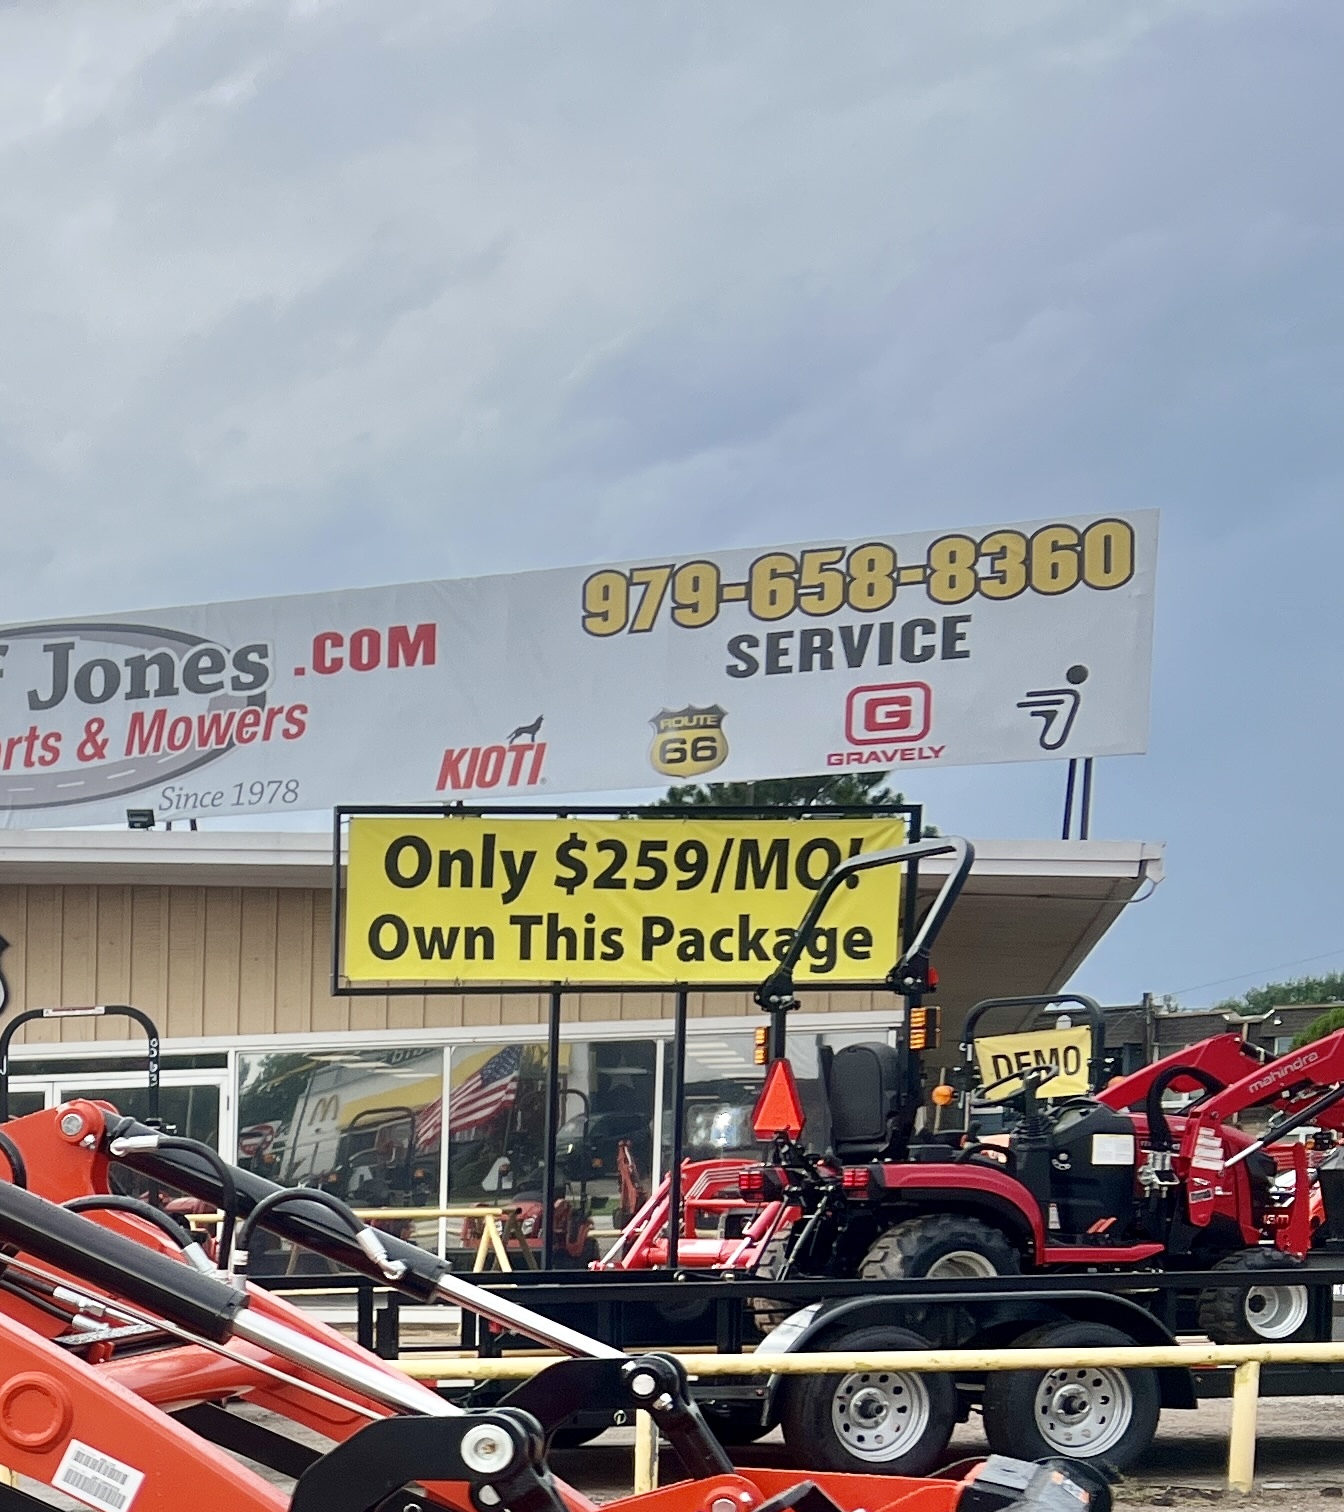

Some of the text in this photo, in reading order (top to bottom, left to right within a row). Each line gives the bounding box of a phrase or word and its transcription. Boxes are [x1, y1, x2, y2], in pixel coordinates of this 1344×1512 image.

[581, 517, 1136, 638] 979-658-8360
[27, 638, 272, 713] Jones
[293, 621, 437, 678] .COM
[725, 614, 973, 680] SERVICE
[76, 715, 110, 762] &
[124, 699, 310, 758] Mowers
[659, 712, 721, 731] ROUTE
[435, 742, 548, 791] KIOTI
[657, 736, 719, 765] 66
[826, 744, 946, 767] GRAVELY
[158, 779, 300, 813] Since 1978
[383, 832, 863, 904] Only $259/MO!
[368, 912, 874, 974] Own This Package
[991, 1045, 1081, 1081] DEMO
[1247, 1049, 1320, 1095] mahindra
